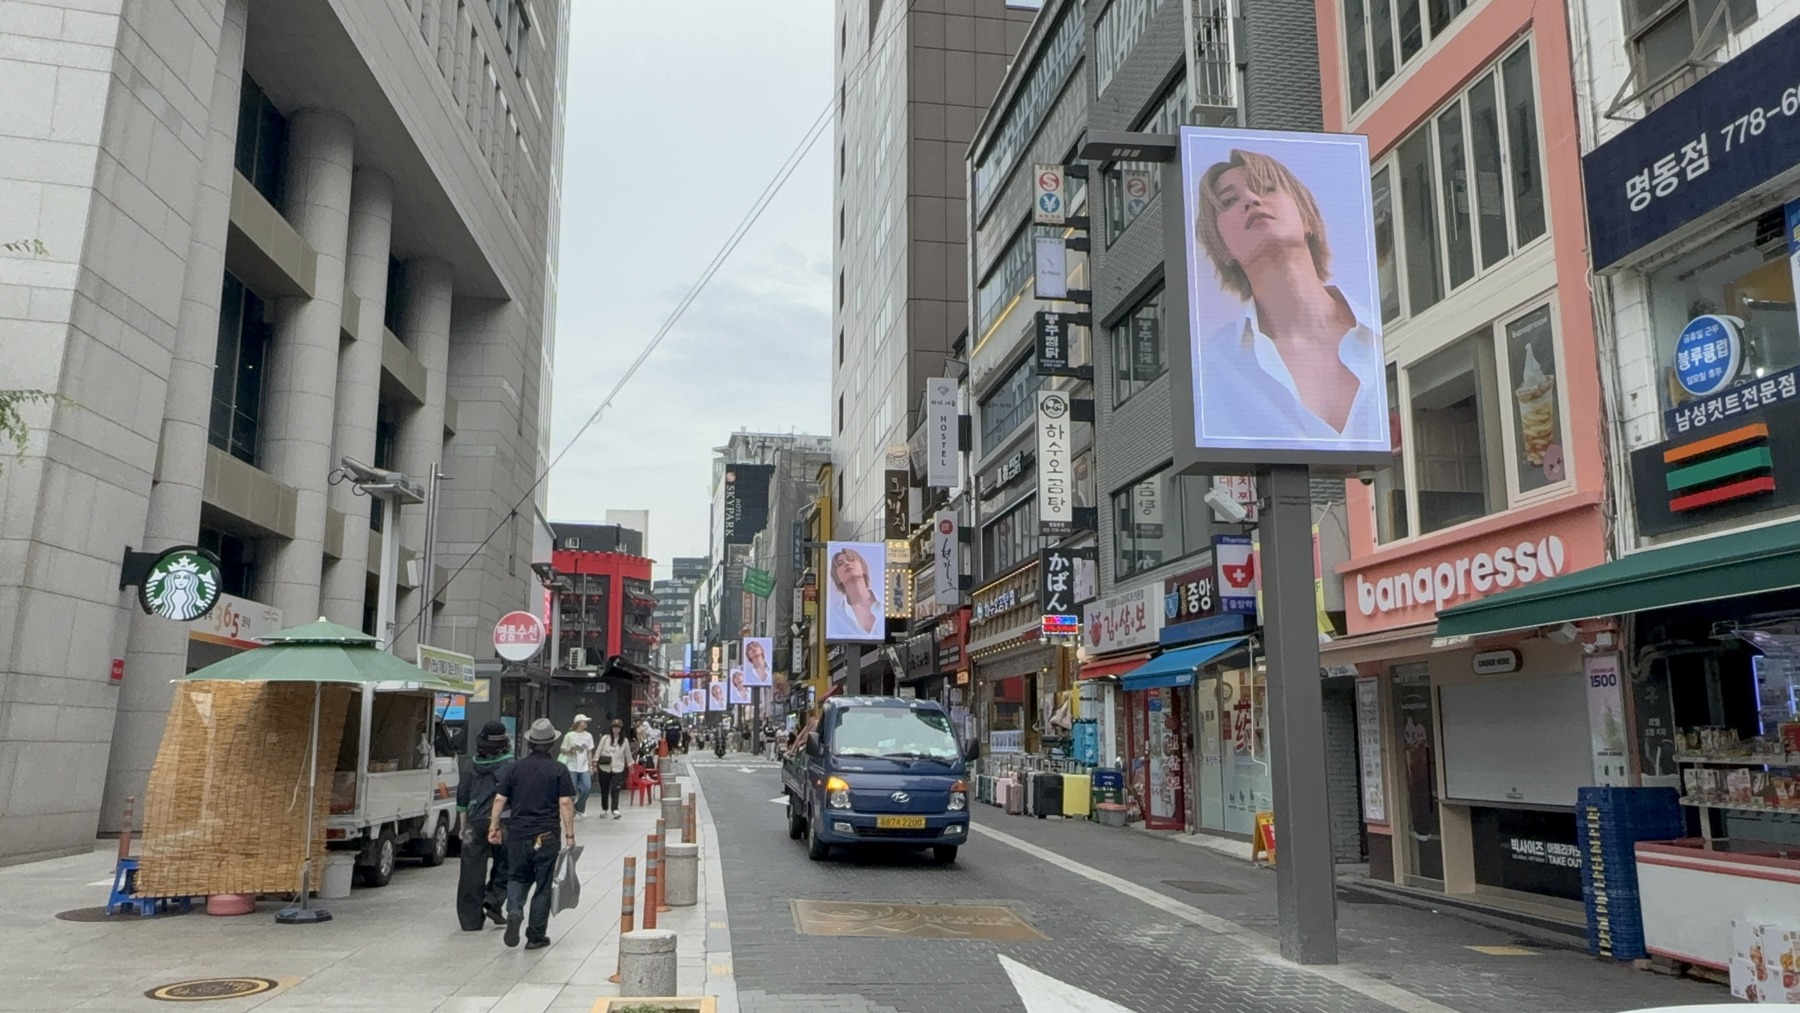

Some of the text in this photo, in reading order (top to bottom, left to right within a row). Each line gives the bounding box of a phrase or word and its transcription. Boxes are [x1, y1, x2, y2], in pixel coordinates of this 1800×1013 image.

[1626, 84, 1800, 212] 명동점 778-6
[1678, 338, 1728, 371] 블루클럽
[1675, 372, 1796, 432] 남성컷트전문점
[1045, 424, 1066, 513] 하수오곰탕
[726, 485, 735, 537] SKYPARK
[1047, 552, 1069, 611] かばん
[1357, 535, 1564, 616] banapresso
[497, 623, 538, 642] 명품수선
[1590, 673, 1616, 688] 1500
[1510, 838, 1544, 856] 빅사이즈
[1548, 855, 1566, 866] TAKE
[1567, 858, 1582, 868] OUT
